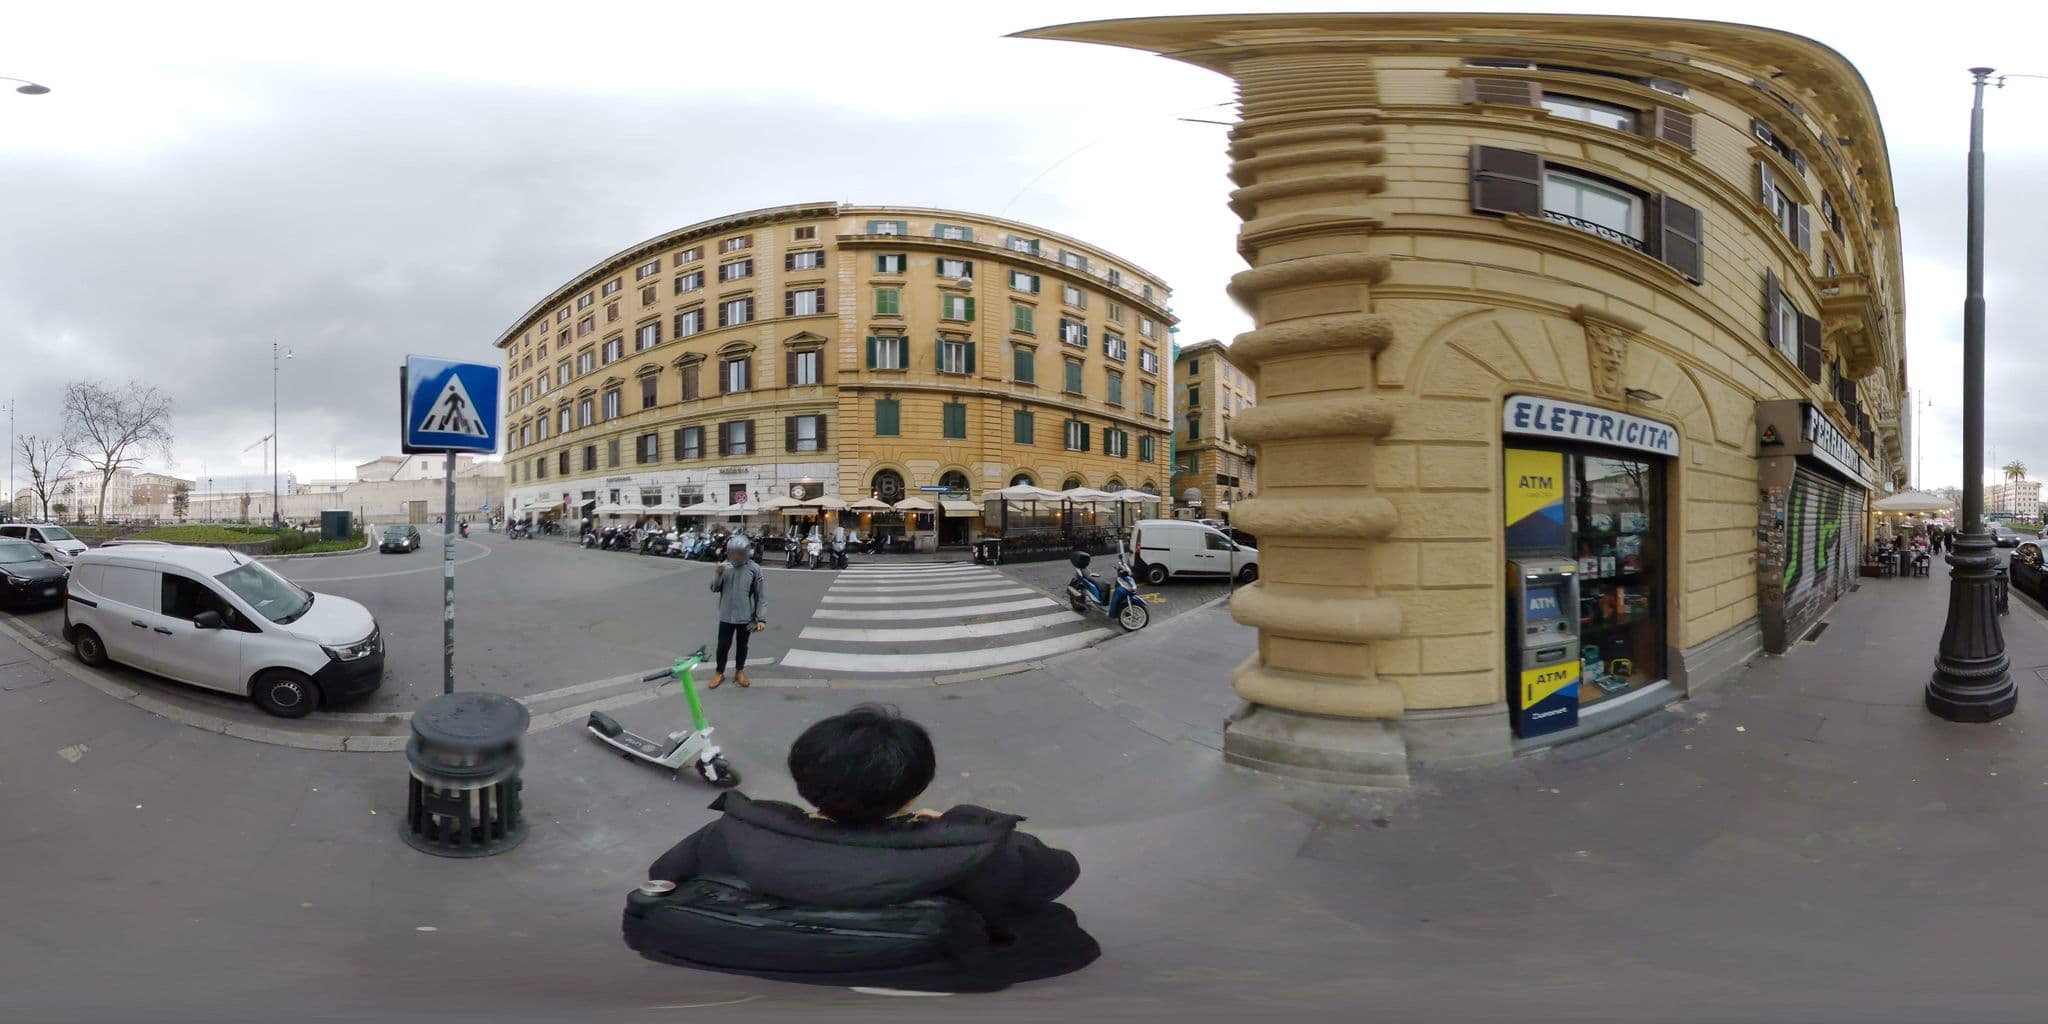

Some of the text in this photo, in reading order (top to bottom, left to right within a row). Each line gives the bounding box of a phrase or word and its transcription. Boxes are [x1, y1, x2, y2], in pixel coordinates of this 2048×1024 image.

[1519, 476, 1553, 490] ATM
[1529, 597, 1556, 611] ATM
[1536, 670, 1567, 685] ATM
